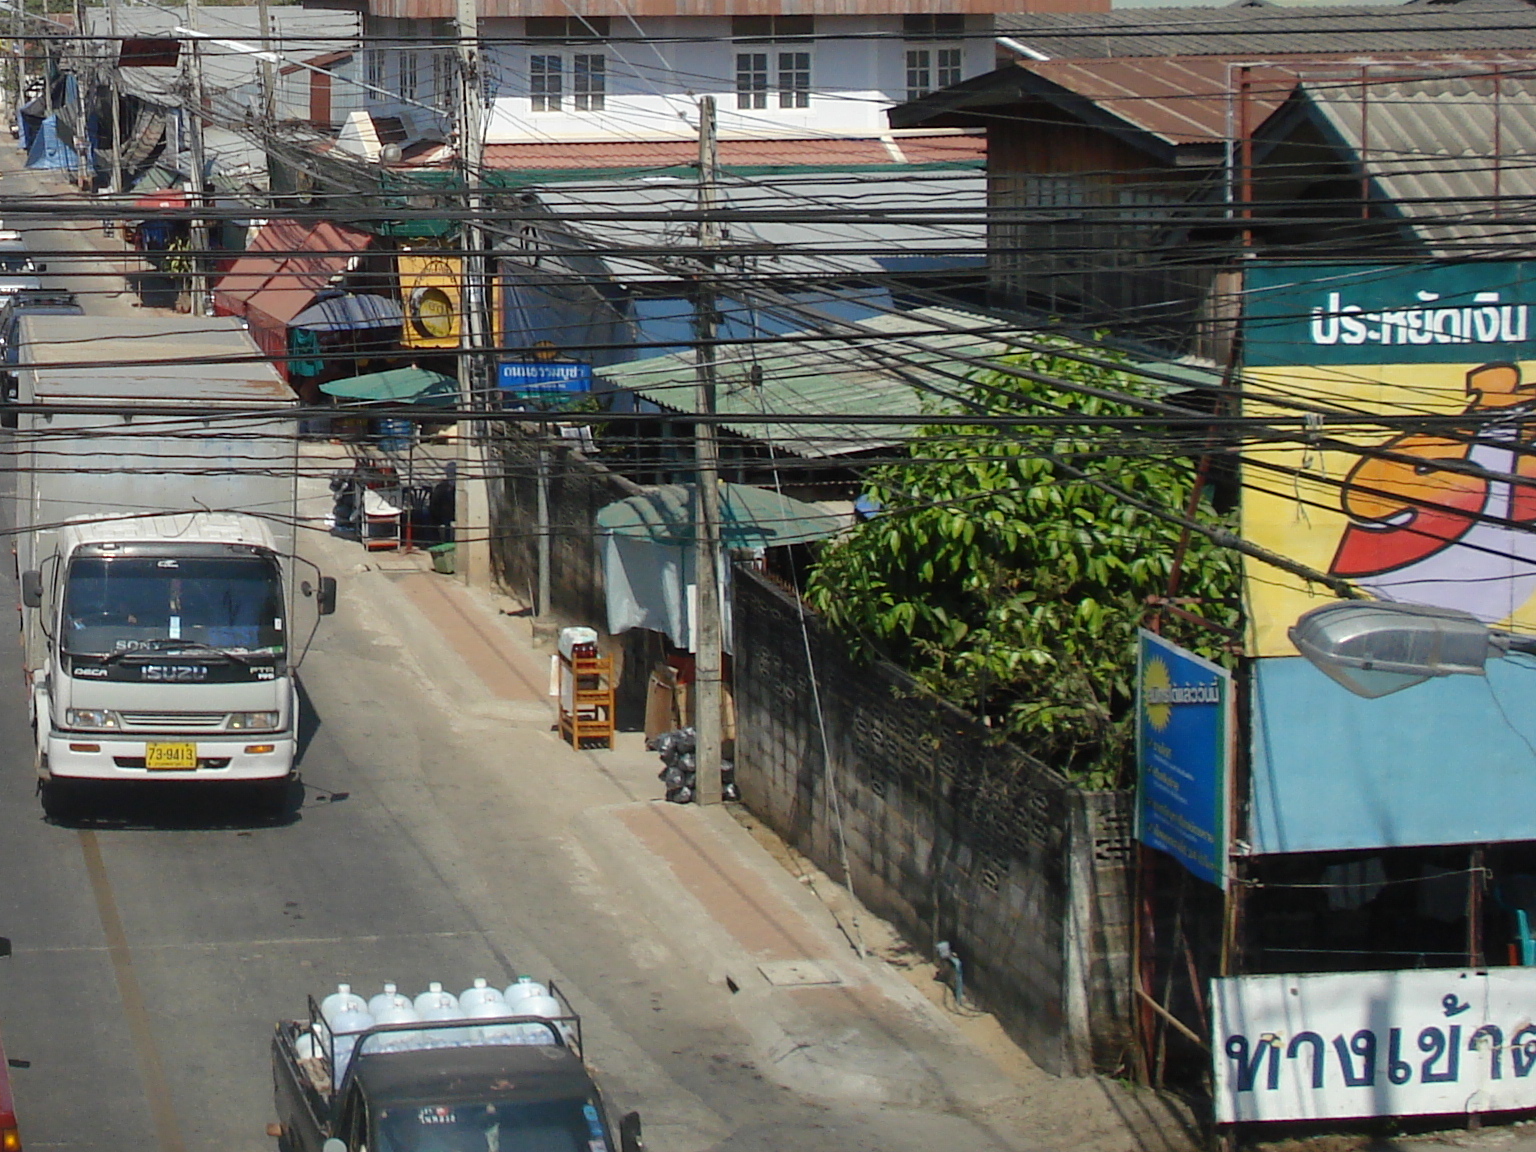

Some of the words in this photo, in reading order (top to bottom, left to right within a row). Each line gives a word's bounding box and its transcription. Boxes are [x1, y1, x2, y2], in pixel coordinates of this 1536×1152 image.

[1312, 290, 1527, 346] ประหยัดเงิน
[116, 640, 162, 650] SONY
[74, 668, 108, 676] DECA
[141, 666, 207, 680] ISUZU
[148, 748, 193, 760] 73-9413
